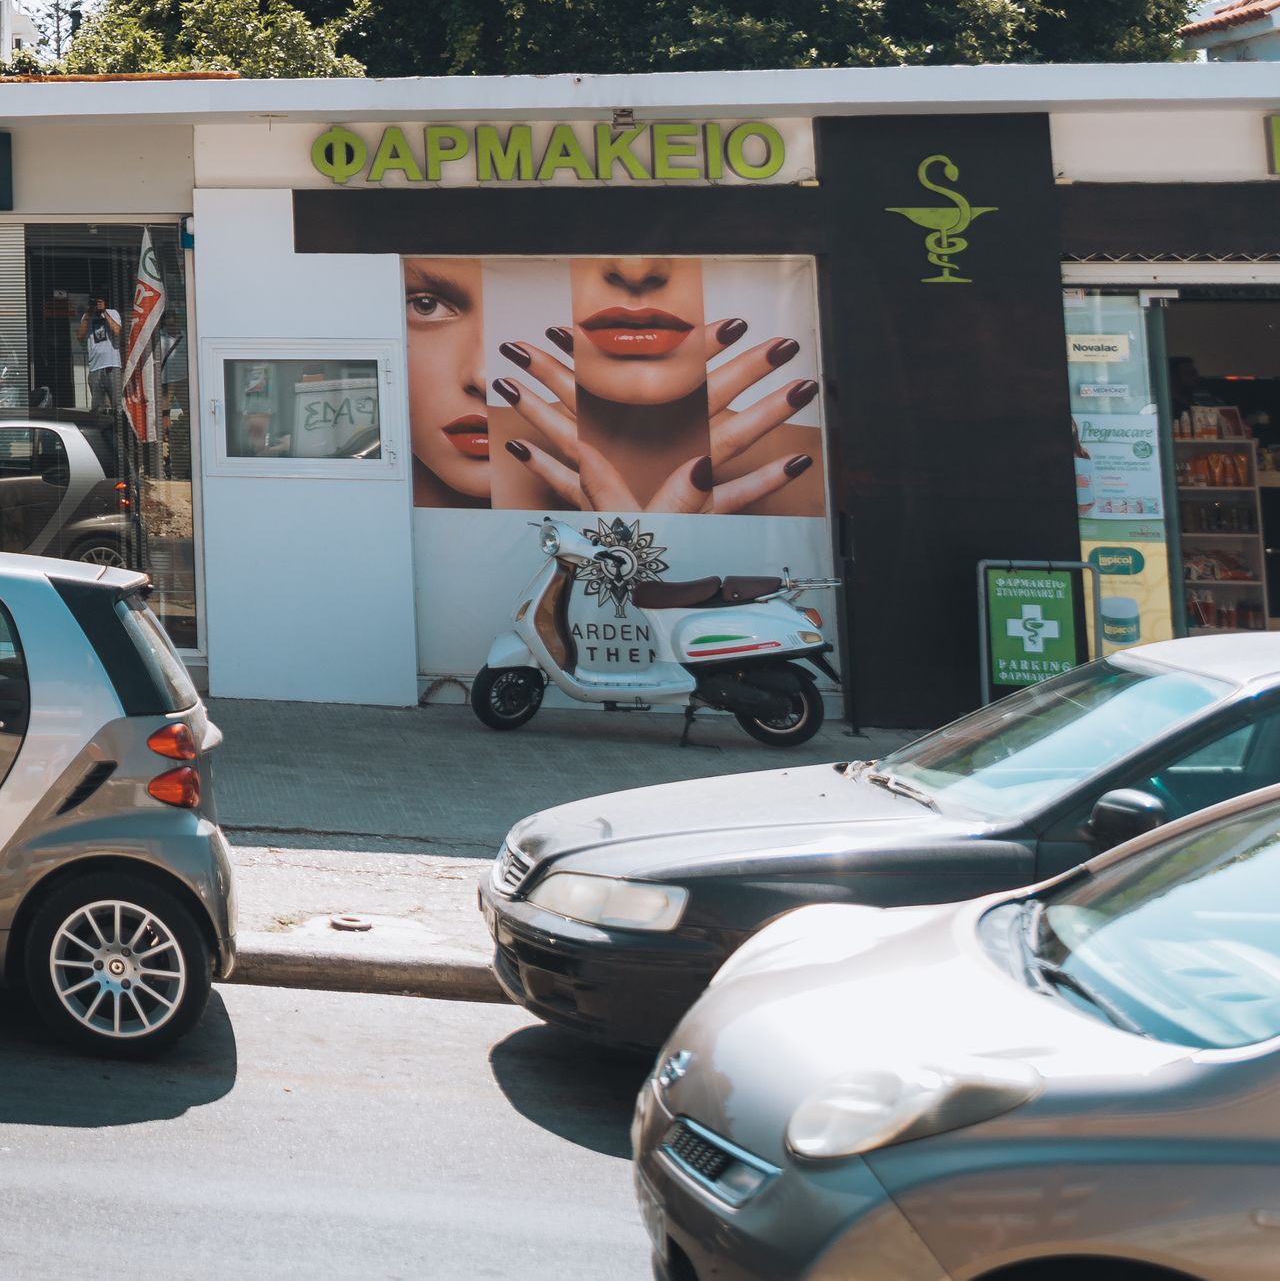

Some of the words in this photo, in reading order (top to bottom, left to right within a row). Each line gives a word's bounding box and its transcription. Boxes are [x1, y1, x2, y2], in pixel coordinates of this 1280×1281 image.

[311, 122, 786, 184] ΦΑΡΜΑΚΕΙΟ
[1072, 343, 1118, 352] Novalac
[1080, 421, 1153, 442] Pregnacare
[996, 578, 1066, 589] ΦΑΡΜΑΚΕΙΟ
[571, 622, 650, 641] ARDEN
[998, 658, 1072, 672] PARKING
